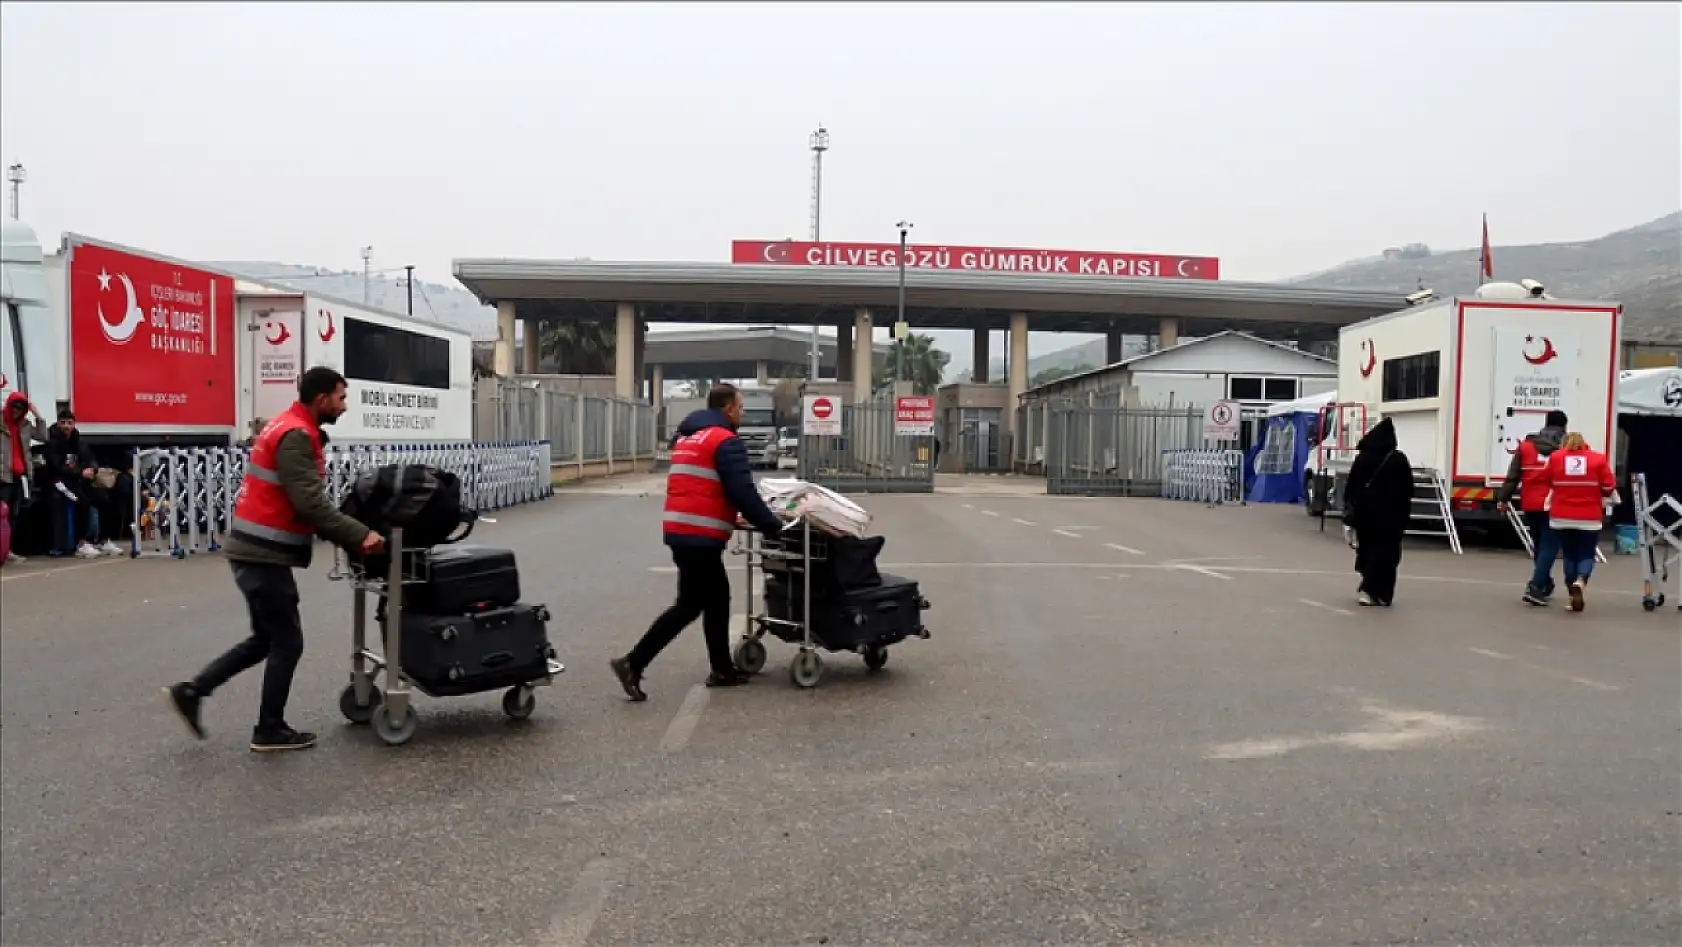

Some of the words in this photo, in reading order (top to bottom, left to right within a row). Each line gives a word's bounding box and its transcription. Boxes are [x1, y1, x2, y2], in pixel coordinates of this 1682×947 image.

[806, 244, 950, 267] CİLVEGÖZÜ
[960, 248, 1069, 273] GÜMRÜK
[1079, 256, 1160, 277] KAPISI
[151, 304, 169, 334] GÖÇ
[170, 306, 204, 334] İDARESİ
[151, 333, 204, 354] BAŞKANLIĞI
